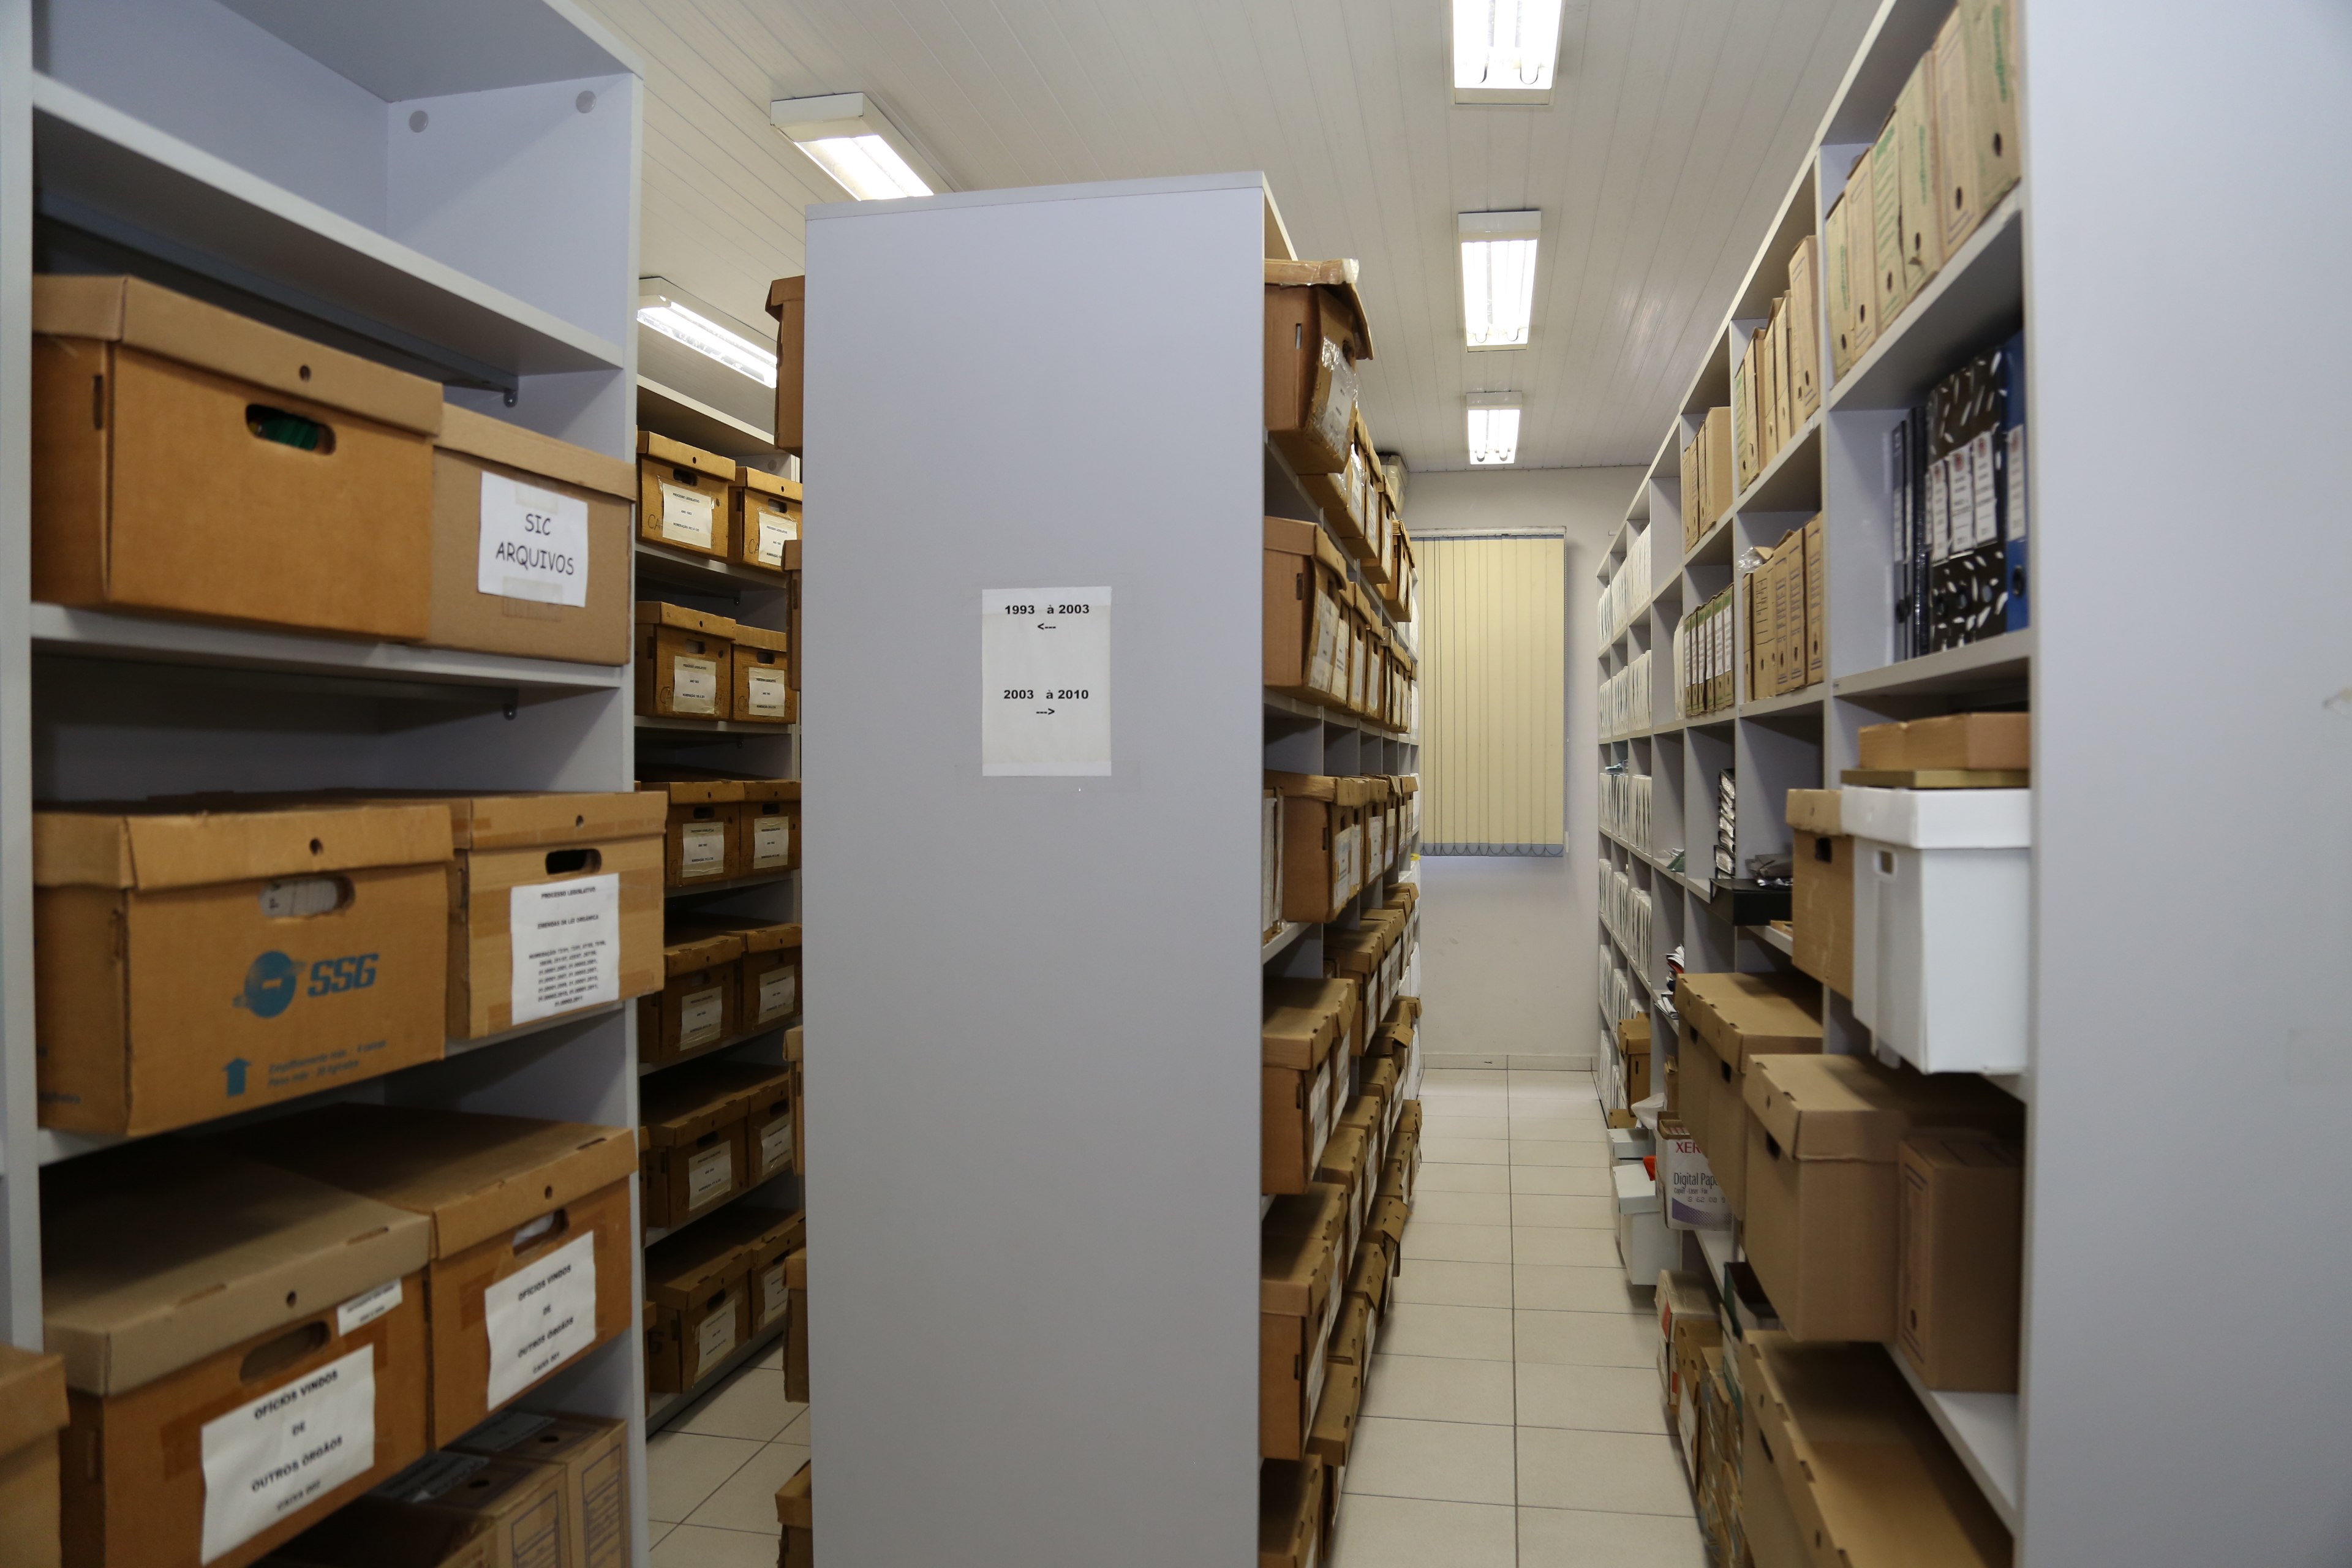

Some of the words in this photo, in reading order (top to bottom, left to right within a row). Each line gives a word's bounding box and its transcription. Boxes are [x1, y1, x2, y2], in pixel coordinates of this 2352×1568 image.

[525, 513, 551, 535] SIC
[496, 541, 574, 575] ARQUIVOS
[1005, 605, 1035, 614] 1993
[1047, 605, 1054, 614] à
[1058, 605, 1090, 614] 2003
[1003, 690, 1034, 699] 2003
[1046, 690, 1054, 699] à
[1058, 690, 1089, 699] 2010
[307, 952, 379, 997] SSG
[1676, 1142, 1701, 1154] XER
[1674, 1172, 1698, 1189] Digital
[543, 1303, 551, 1316] DE
[518, 1335, 545, 1358] OUTROS
[300, 1368, 338, 1396] VINDOS
[292, 1421, 306, 1436] DE
[251, 1460, 299, 1493] OUTROS
